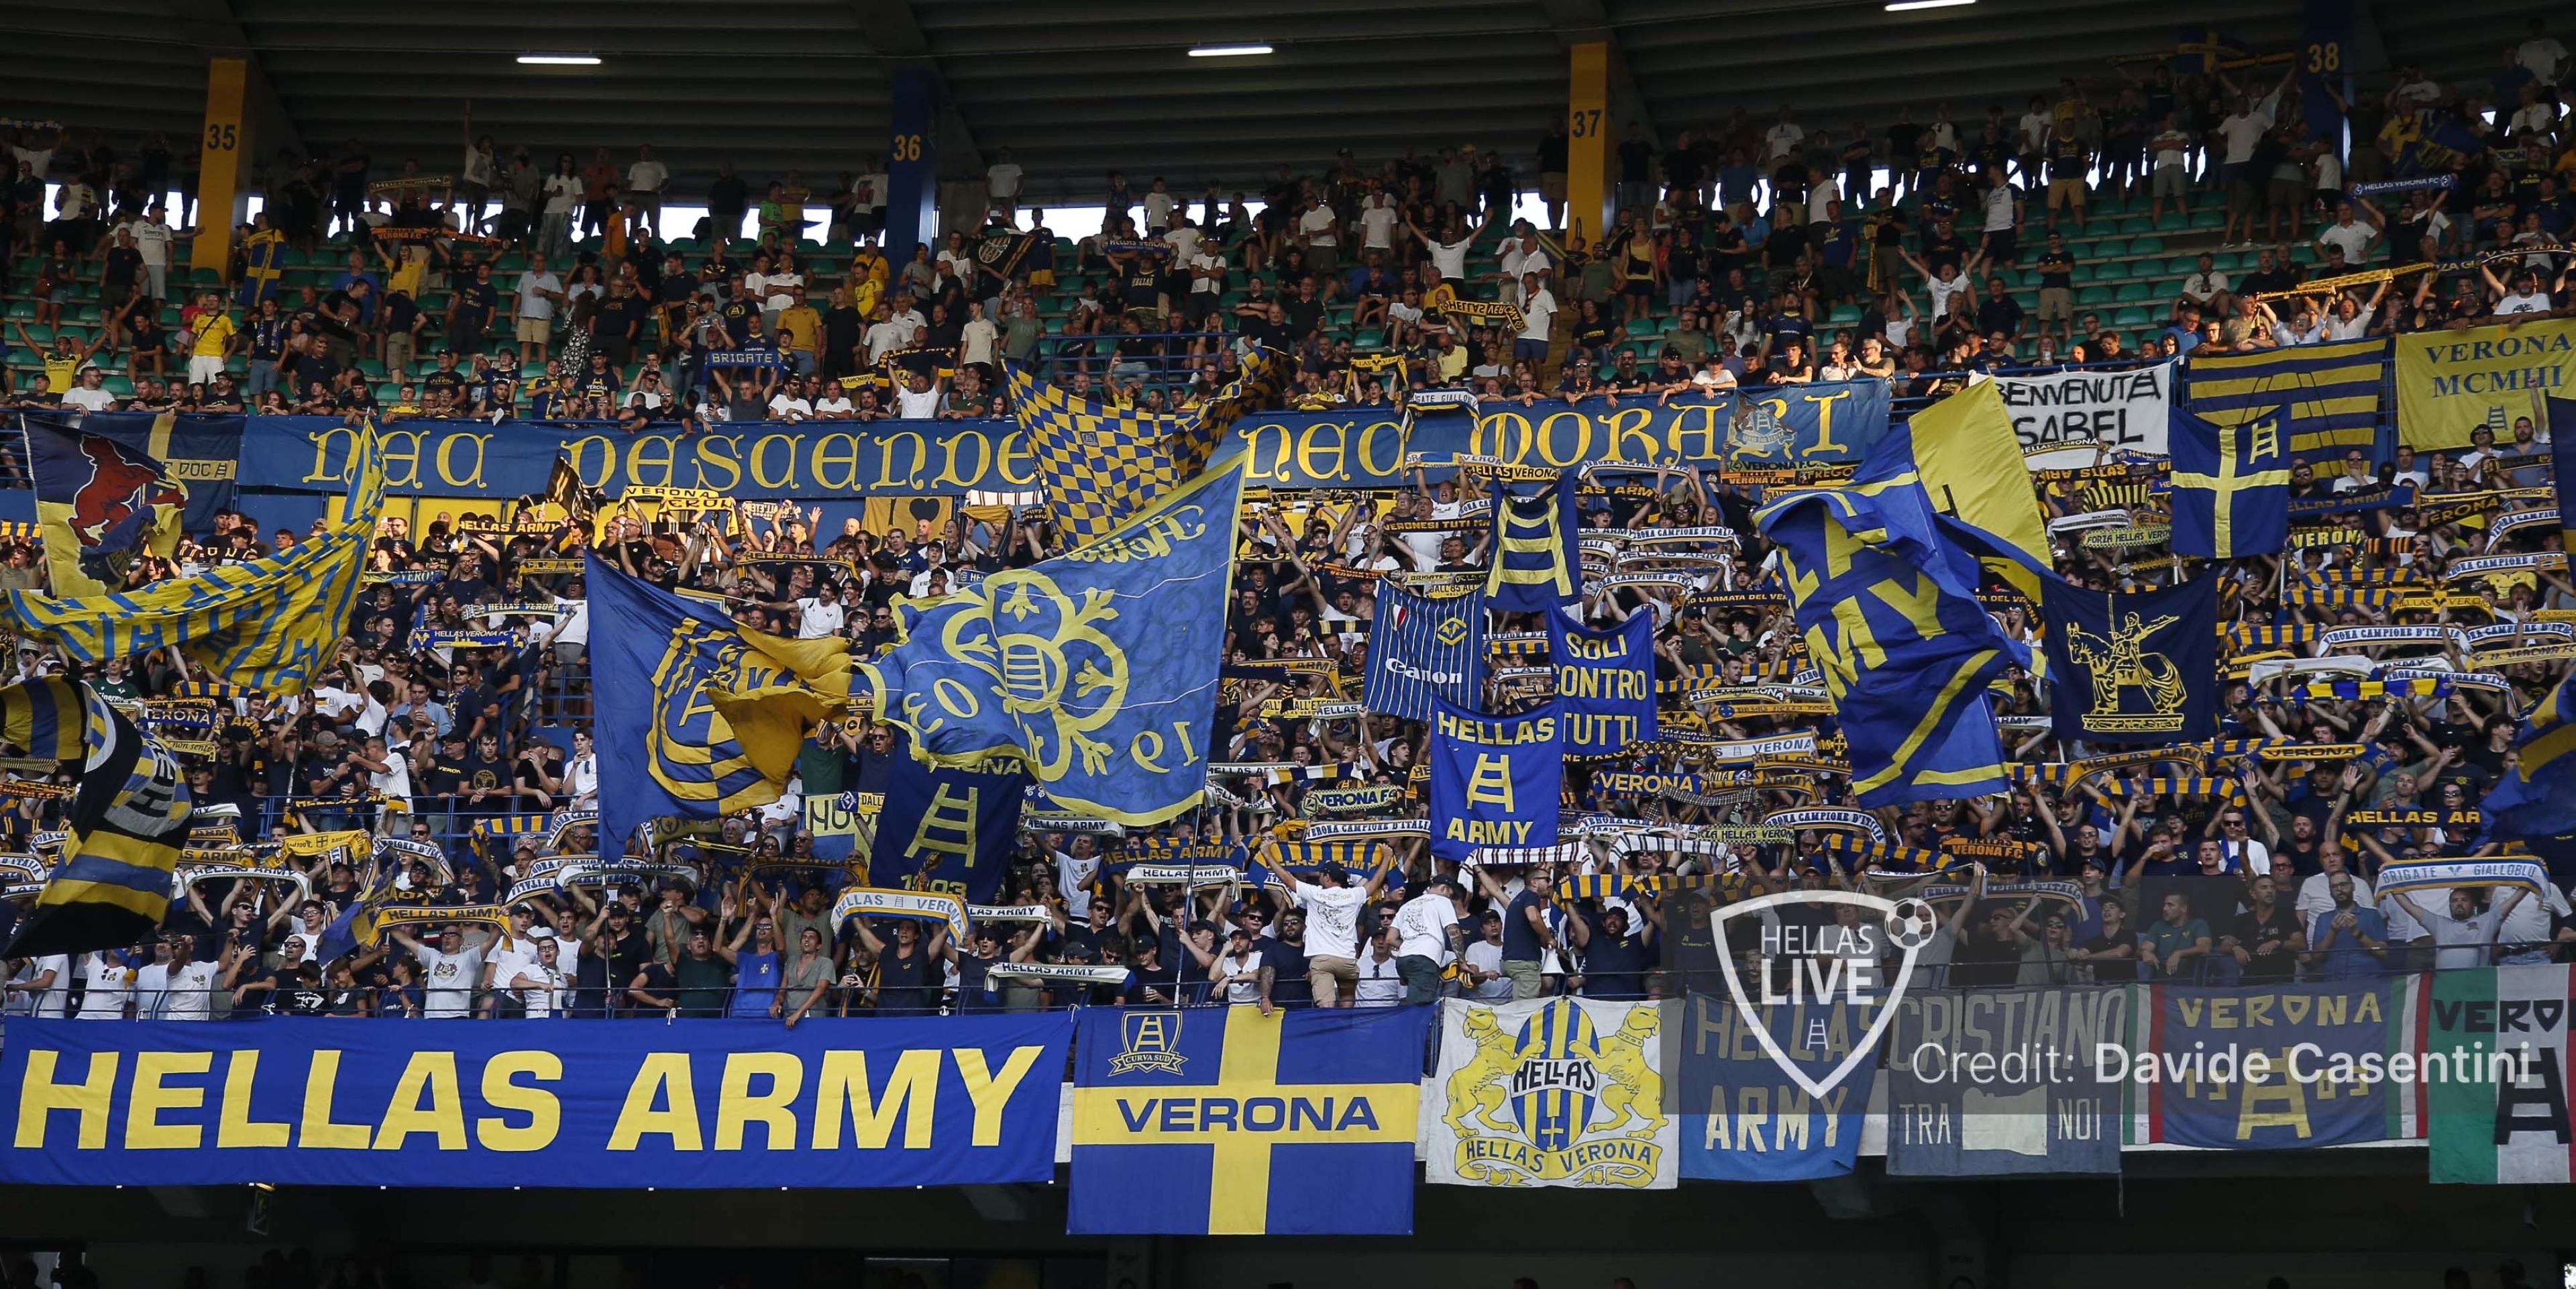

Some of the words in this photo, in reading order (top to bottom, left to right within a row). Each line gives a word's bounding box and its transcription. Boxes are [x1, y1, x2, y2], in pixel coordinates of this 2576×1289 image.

[2308, 42, 2340, 74] 38
[1572, 109, 1601, 138] 37
[207, 124, 236, 150] 35
[892, 135, 922, 162] 36
[2365, 181, 2393, 191] HELLAS
[2394, 178, 2426, 187] VERONA
[2426, 332, 2573, 364] VERONA
[712, 353, 773, 364] BRIGATE
[2433, 366, 2563, 398] MCMIII
[179, 462, 211, 477] DOC
[1744, 460, 1796, 470] VERONA
[1515, 466, 1557, 479] VERONA
[627, 487, 711, 499] VERONA
[1573, 485, 1607, 495] LAS
[2430, 495, 2500, 525] ERONA
[515, 522, 560, 533] ARMY
[1658, 527, 1699, 535] CAMPIONE
[2087, 535, 2112, 544] FORZA
[2116, 533, 2144, 542] HELLAS
[2477, 557, 2528, 568] CAMPIONE
[1615, 574, 1666, 582] CAMPIONE
[1698, 595, 1746, 604] L'ARMATA
[488, 603, 520, 612] HELLAS
[2361, 627, 2413, 639] CAMPIONE
[1566, 631, 1627, 660] SOLI
[1385, 658, 1462, 684] Canon
[1554, 665, 1646, 701] CONTRO
[1316, 707, 1357, 715] HELLAS
[1438, 711, 1555, 746] HELLAS
[173, 741, 189, 752] non
[1753, 739, 1812, 756] VERONA
[2267, 745, 2357, 757] VERONA
[2082, 750, 2150, 771] HELLAS
[1599, 774, 1693, 792] VERONA
[1317, 789, 1376, 806] VERONA
[1799, 813, 1849, 821] CAMPIONE
[2348, 811, 2438, 824] HELLAS
[2448, 811, 2480, 823] AR
[1029, 820, 1071, 830] HELLAS
[1073, 821, 1106, 831] ARMY
[1446, 817, 1533, 845] ARMY
[1722, 827, 1756, 839] HELLAS
[1104, 849, 1174, 863] HELLAS
[1952, 845, 2002, 858] VERONA
[2004, 847, 2024, 858] F.C.
[582, 864, 634, 872] HELLAS
[1143, 868, 1191, 877] HELLAS
[2382, 866, 2437, 884] BRIGATE
[2473, 864, 2536, 878] GIALLOBLU
[900, 875, 967, 896] 103
[388, 910, 449, 921] HELLAS
[457, 909, 500, 921] ARMY
[835, 894, 883, 918] HELLAS
[916, 898, 963, 931] VERONA
[997, 907, 1035, 916] ARMY
[1002, 963, 1051, 976] HELLAS
[1056, 966, 1095, 976] ARMY
[2178, 992, 2382, 1029] VERONA
[2432, 1000, 2576, 1033] VERO
[1890, 988, 2127, 1072] CRISTIANO
[1126, 1055, 1153, 1064] CURVA
[1155, 1054, 1171, 1062] SUD
[1513, 1061, 1596, 1093] HELLAS
[13, 1049, 561, 1153] HELLAS
[607, 1045, 1045, 1152] ARMY
[1116, 1096, 1379, 1132] VERONA
[1706, 1086, 1847, 1153] ARMY
[1899, 1102, 1951, 1145] TRA
[2058, 1098, 2100, 1140] NOI
[1466, 1141, 1544, 1172] HELLAS
[1560, 1143, 1651, 1172] VERONA
